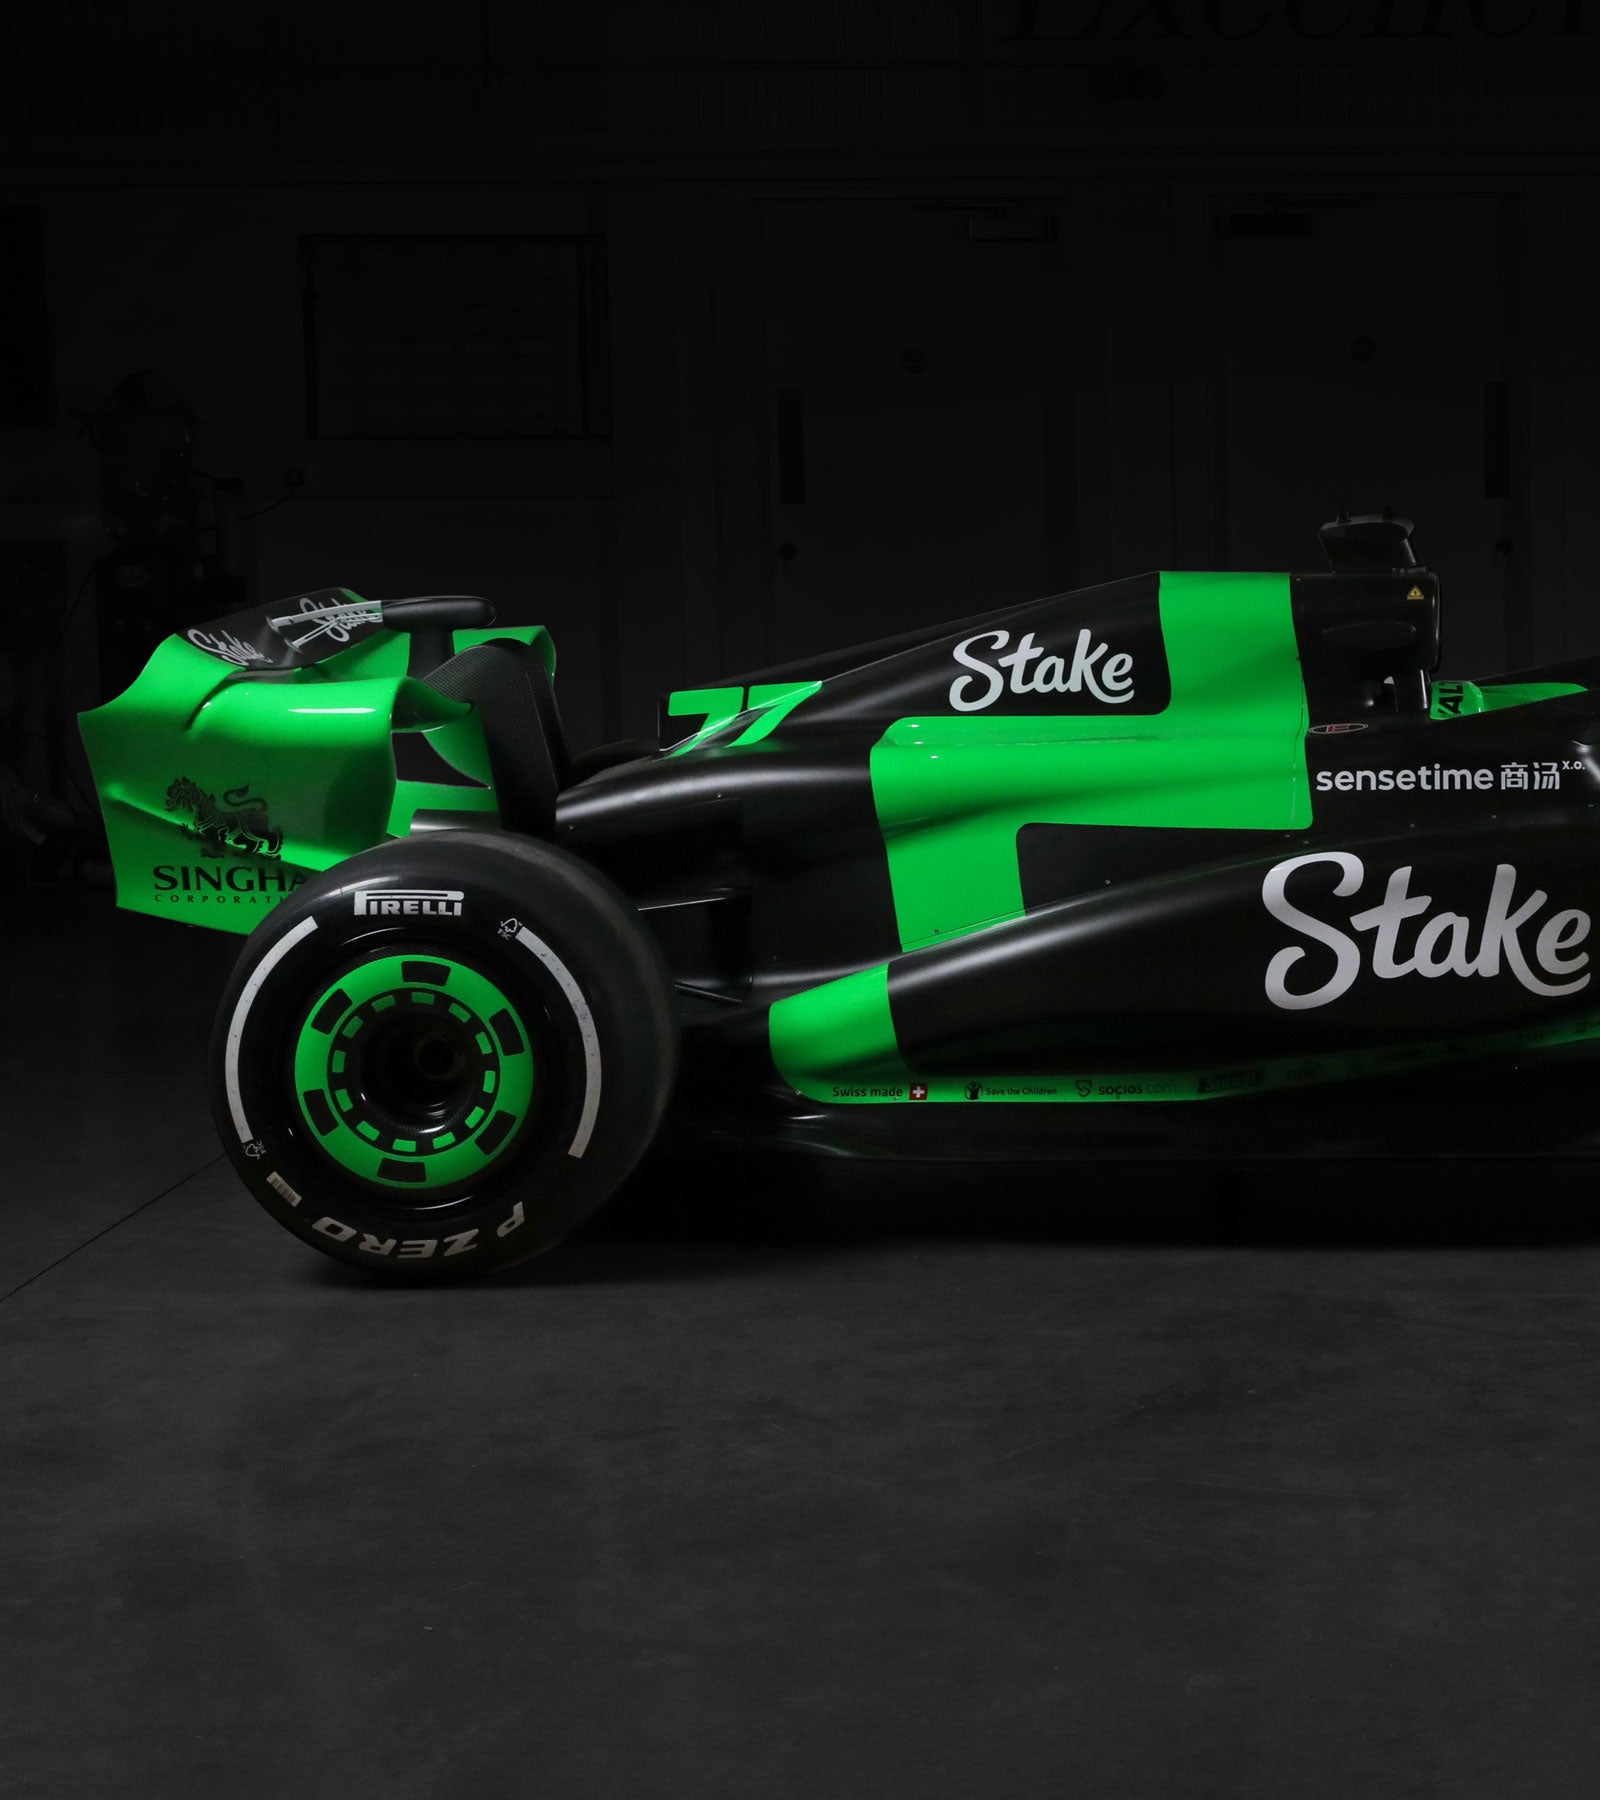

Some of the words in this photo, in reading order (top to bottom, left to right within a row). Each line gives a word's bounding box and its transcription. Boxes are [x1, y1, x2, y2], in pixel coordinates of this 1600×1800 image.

[948, 628, 1135, 712] Stake
[666, 680, 823, 758] 77
[1315, 763, 1494, 791] sensetime
[1501, 762, 1560, 790] 商汤
[353, 890, 465, 916] PIRELLI
[1262, 851, 1591, 1010] Stake
[833, 1086, 867, 1097] Swiss
[870, 1086, 903, 1097] made
[986, 1087, 1006, 1096] Save
[1007, 1087, 1021, 1096] the
[1022, 1086, 1058, 1096] Children
[312, 1216, 480, 1258] ZERO
[496, 1201, 525, 1237] P
